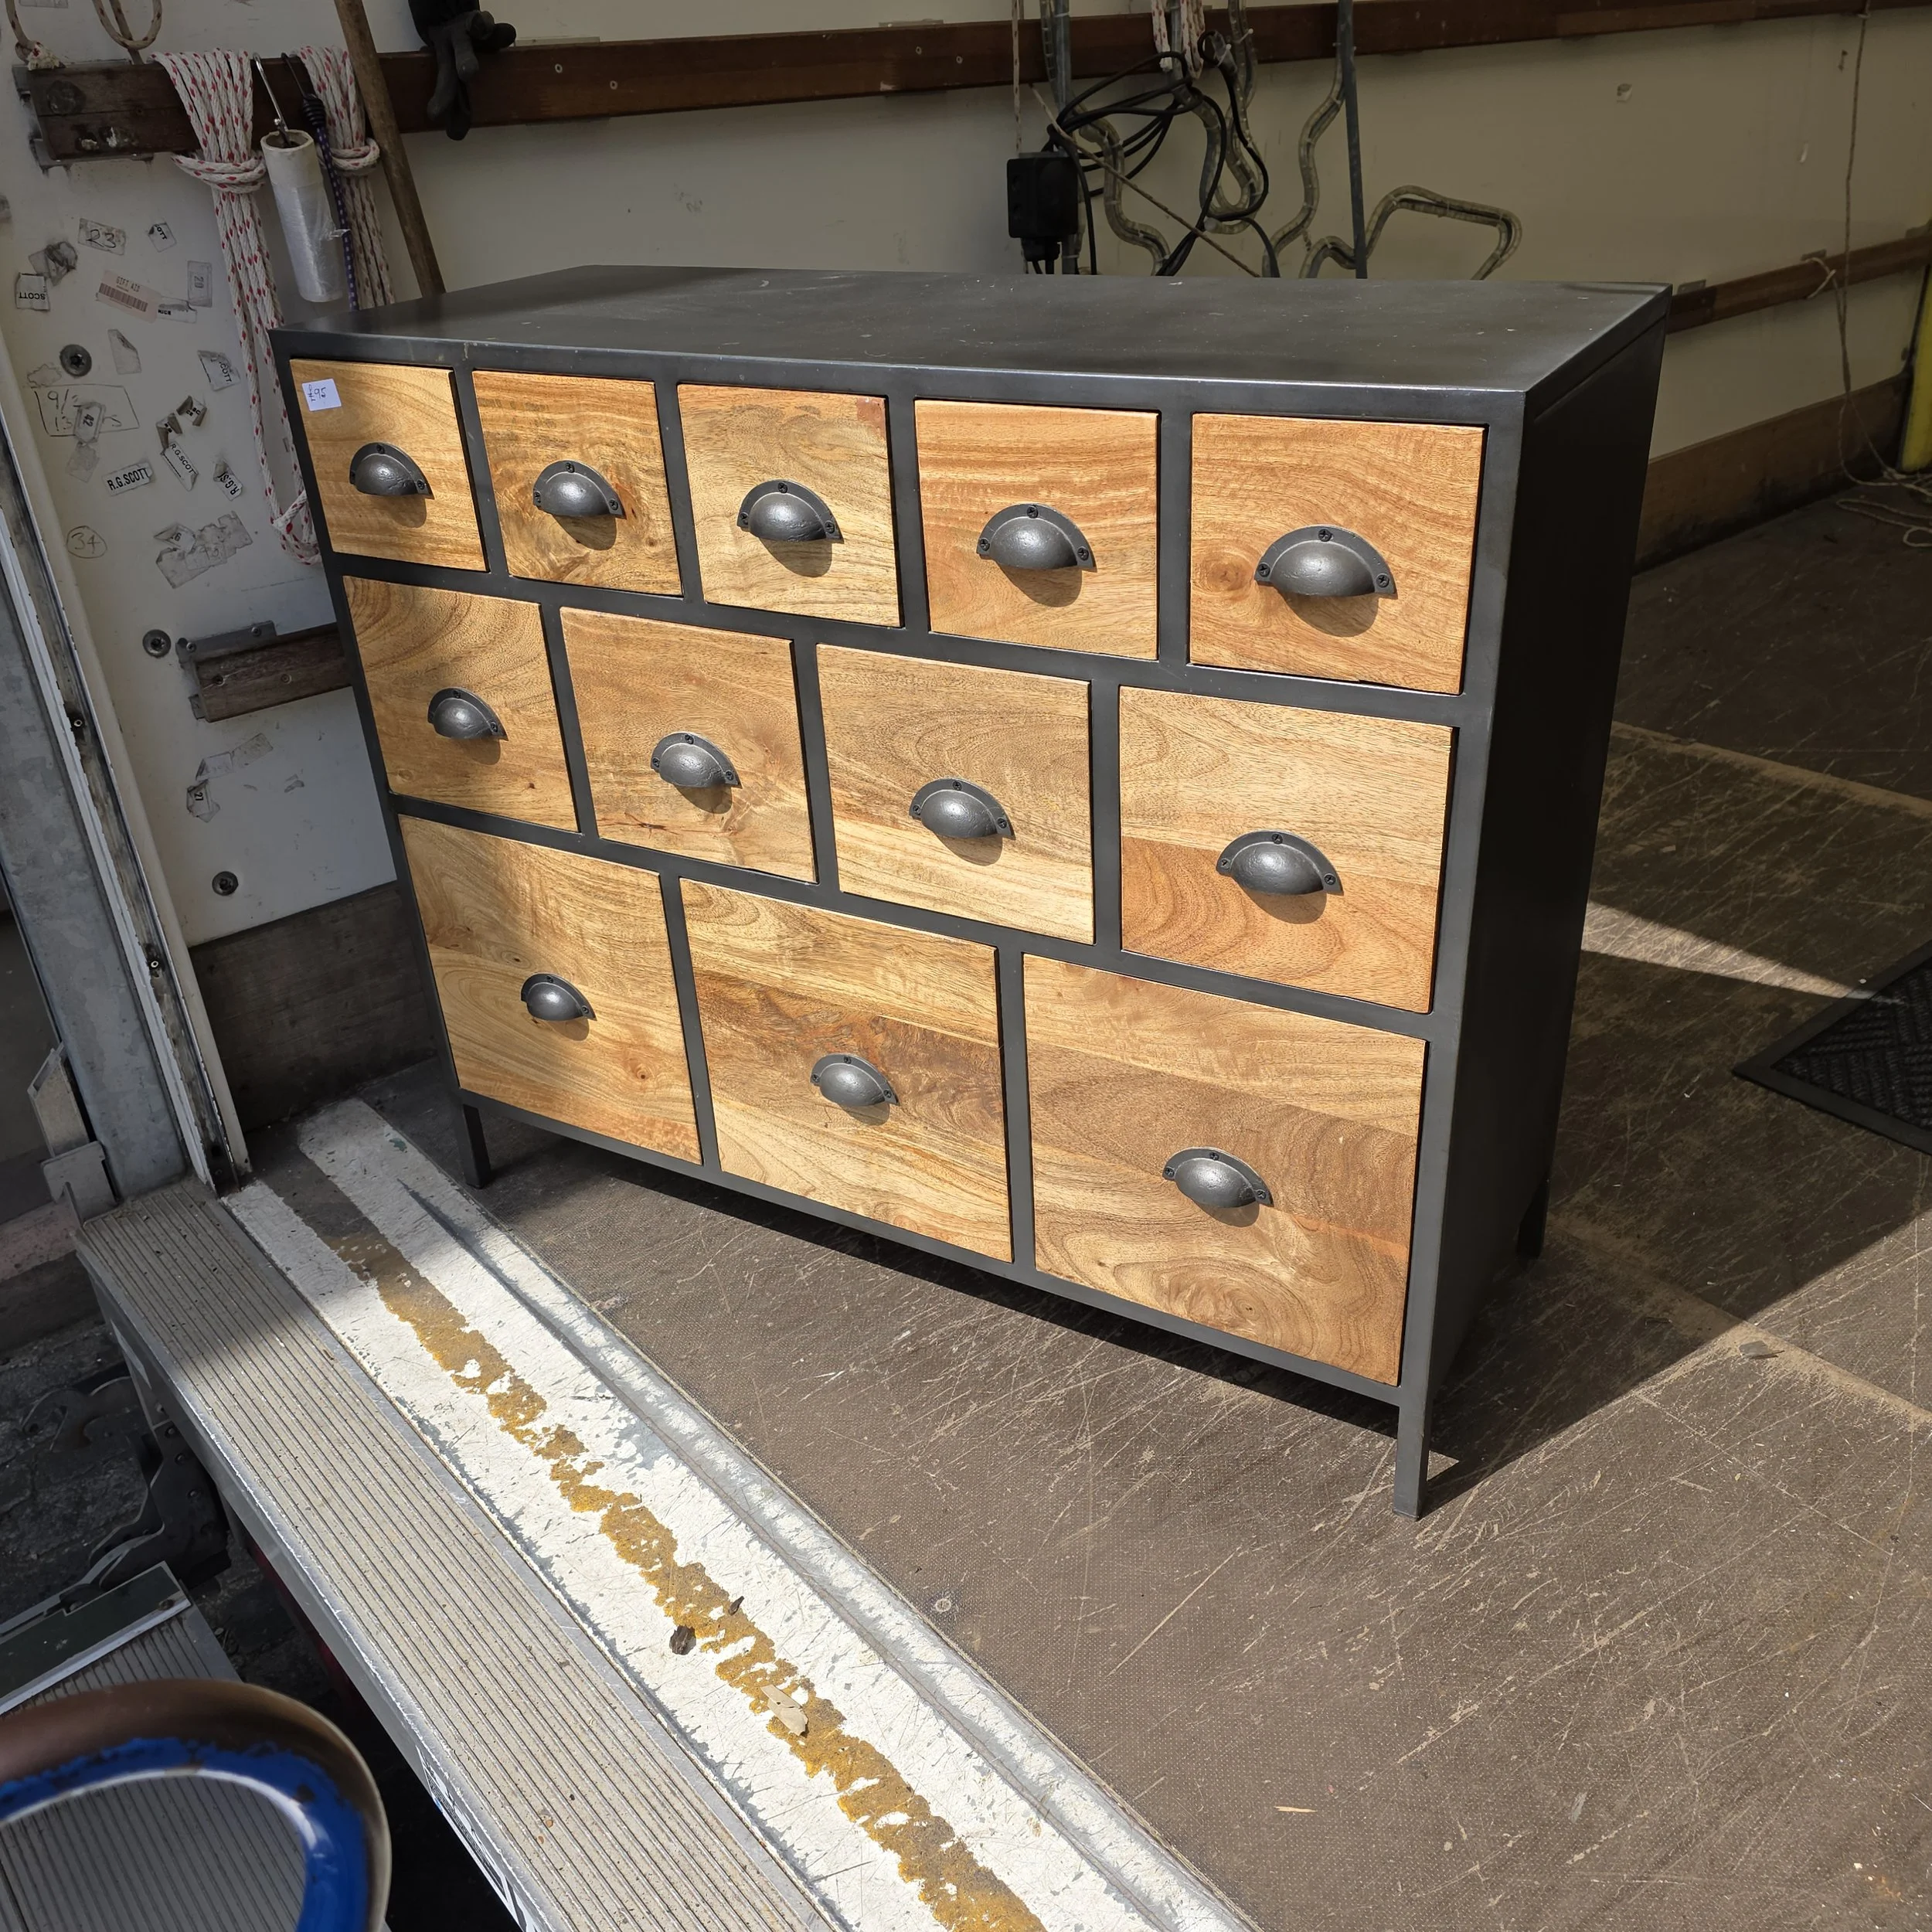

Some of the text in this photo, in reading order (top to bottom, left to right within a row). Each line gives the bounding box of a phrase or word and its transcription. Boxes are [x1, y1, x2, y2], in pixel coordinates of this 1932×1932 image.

[19, 291, 46, 300] SCOTT
[308, 383, 326, 402] £95
[107, 467, 149, 491] R.G.SCOTT
[70, 531, 102, 554] 34
